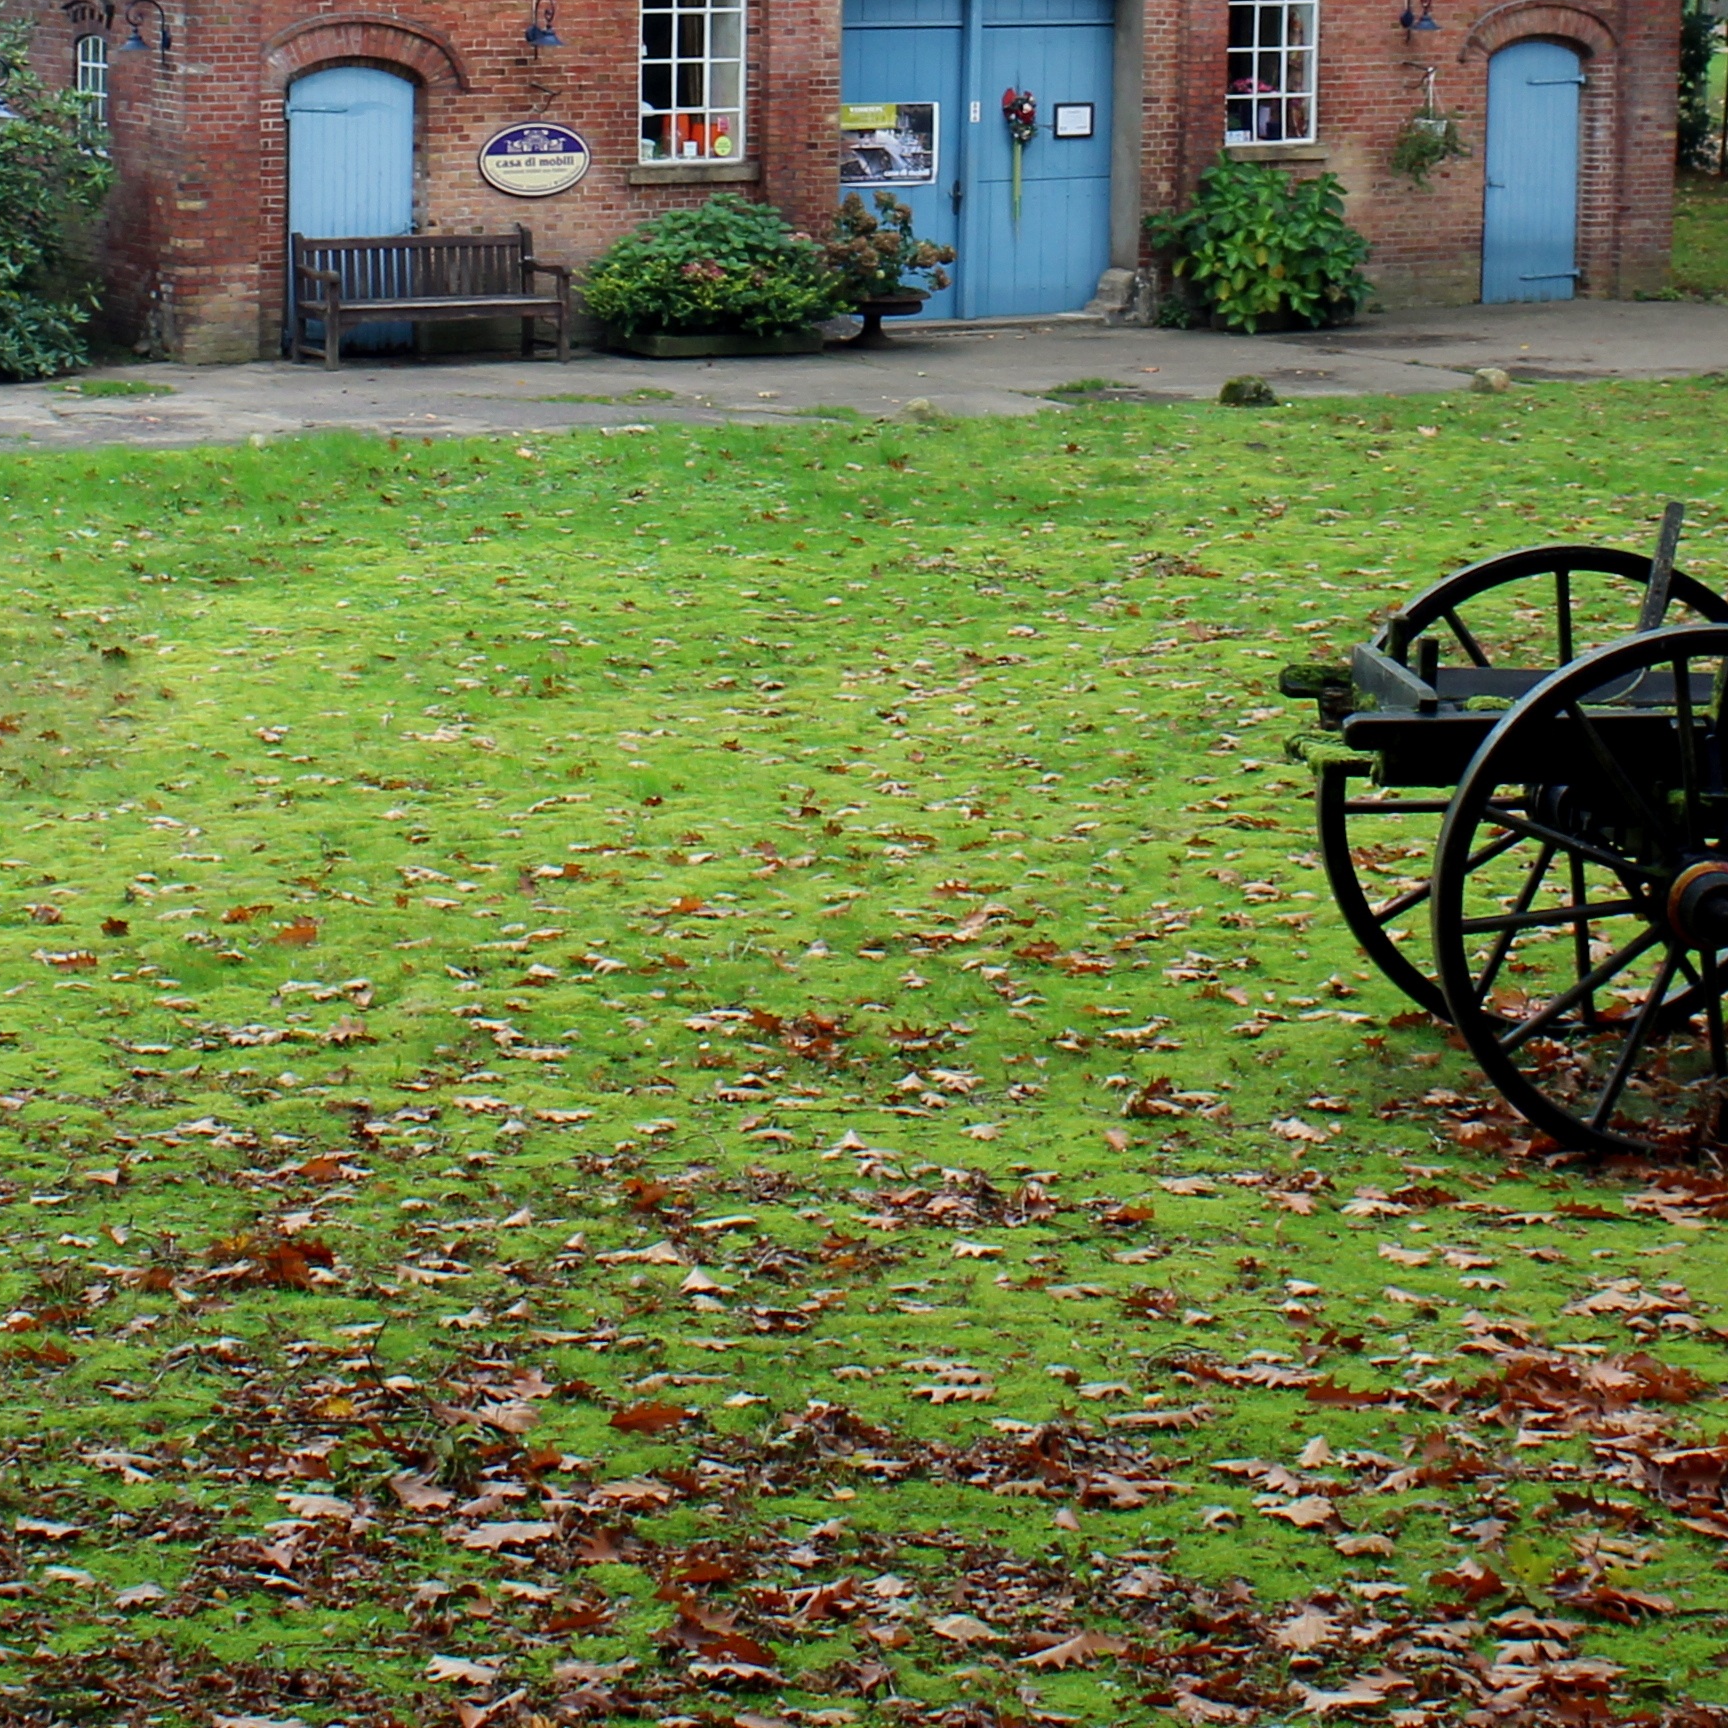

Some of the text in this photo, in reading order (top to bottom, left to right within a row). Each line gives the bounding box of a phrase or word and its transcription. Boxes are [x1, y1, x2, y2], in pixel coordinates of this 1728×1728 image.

[495, 156, 575, 168] casa di mobili
